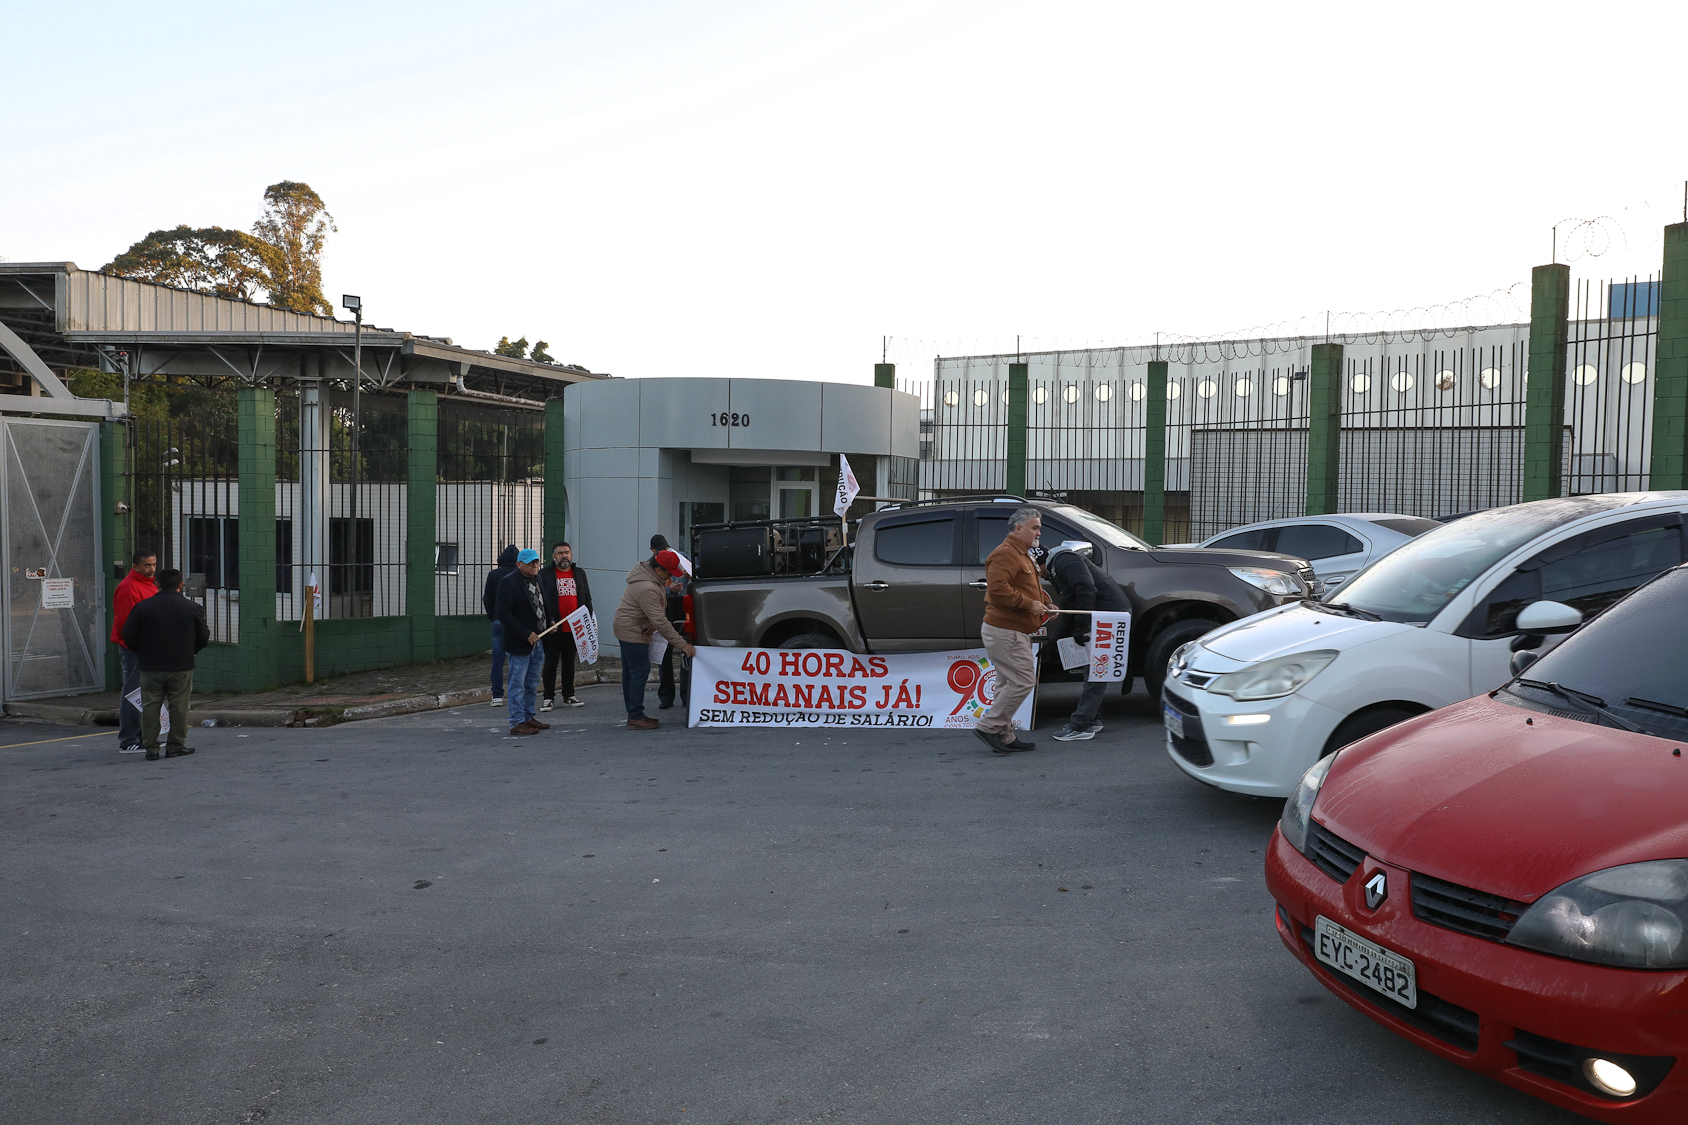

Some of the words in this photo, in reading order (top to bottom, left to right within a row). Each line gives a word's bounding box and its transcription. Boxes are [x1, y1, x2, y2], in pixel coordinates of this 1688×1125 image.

[711, 412, 750, 427] 1620
[572, 619, 585, 640] JÁ!
[583, 613, 596, 651] REDUÇÃO
[1095, 621, 1115, 649] JÁ!
[1112, 622, 1126, 678] REDUÇÃO
[741, 651, 771, 675] 40
[779, 652, 888, 678] HORAS
[713, 680, 867, 709] SEMANAIS
[875, 678, 922, 709] JÁ!
[699, 709, 736, 723] SEM
[739, 711, 820, 726] REDUÇÃO
[823, 713, 847, 725] DE
[850, 711, 934, 727] SALÁRIO!
[945, 715, 970, 724] ANOS
